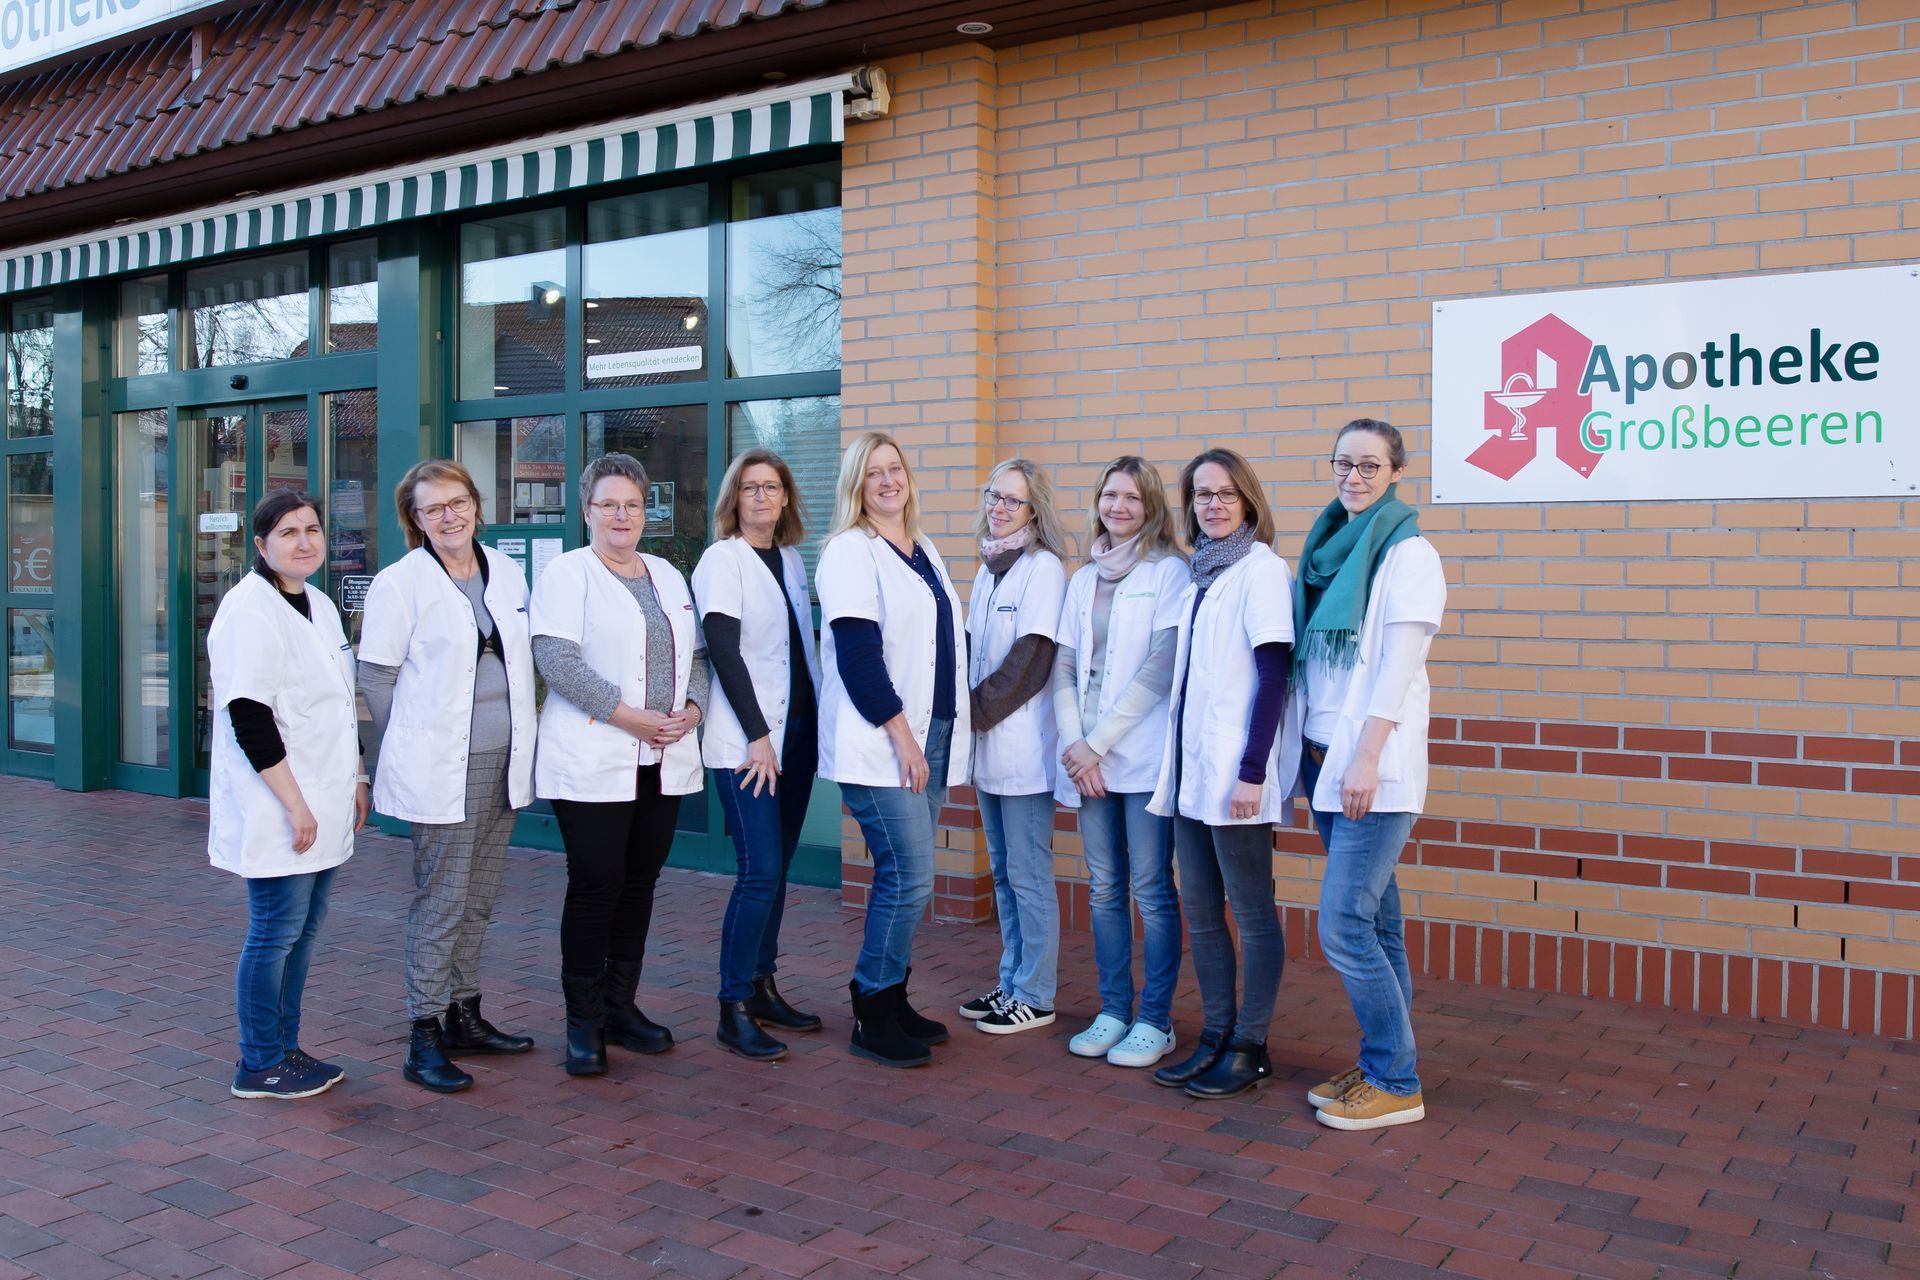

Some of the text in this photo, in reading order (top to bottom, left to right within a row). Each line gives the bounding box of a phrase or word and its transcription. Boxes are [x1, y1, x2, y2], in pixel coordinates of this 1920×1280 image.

[588, 354, 700, 371] Mehr Lebensqualität entdecken
[1578, 328, 1880, 404] Apotheke
[1580, 404, 1883, 452] Großbeeren
